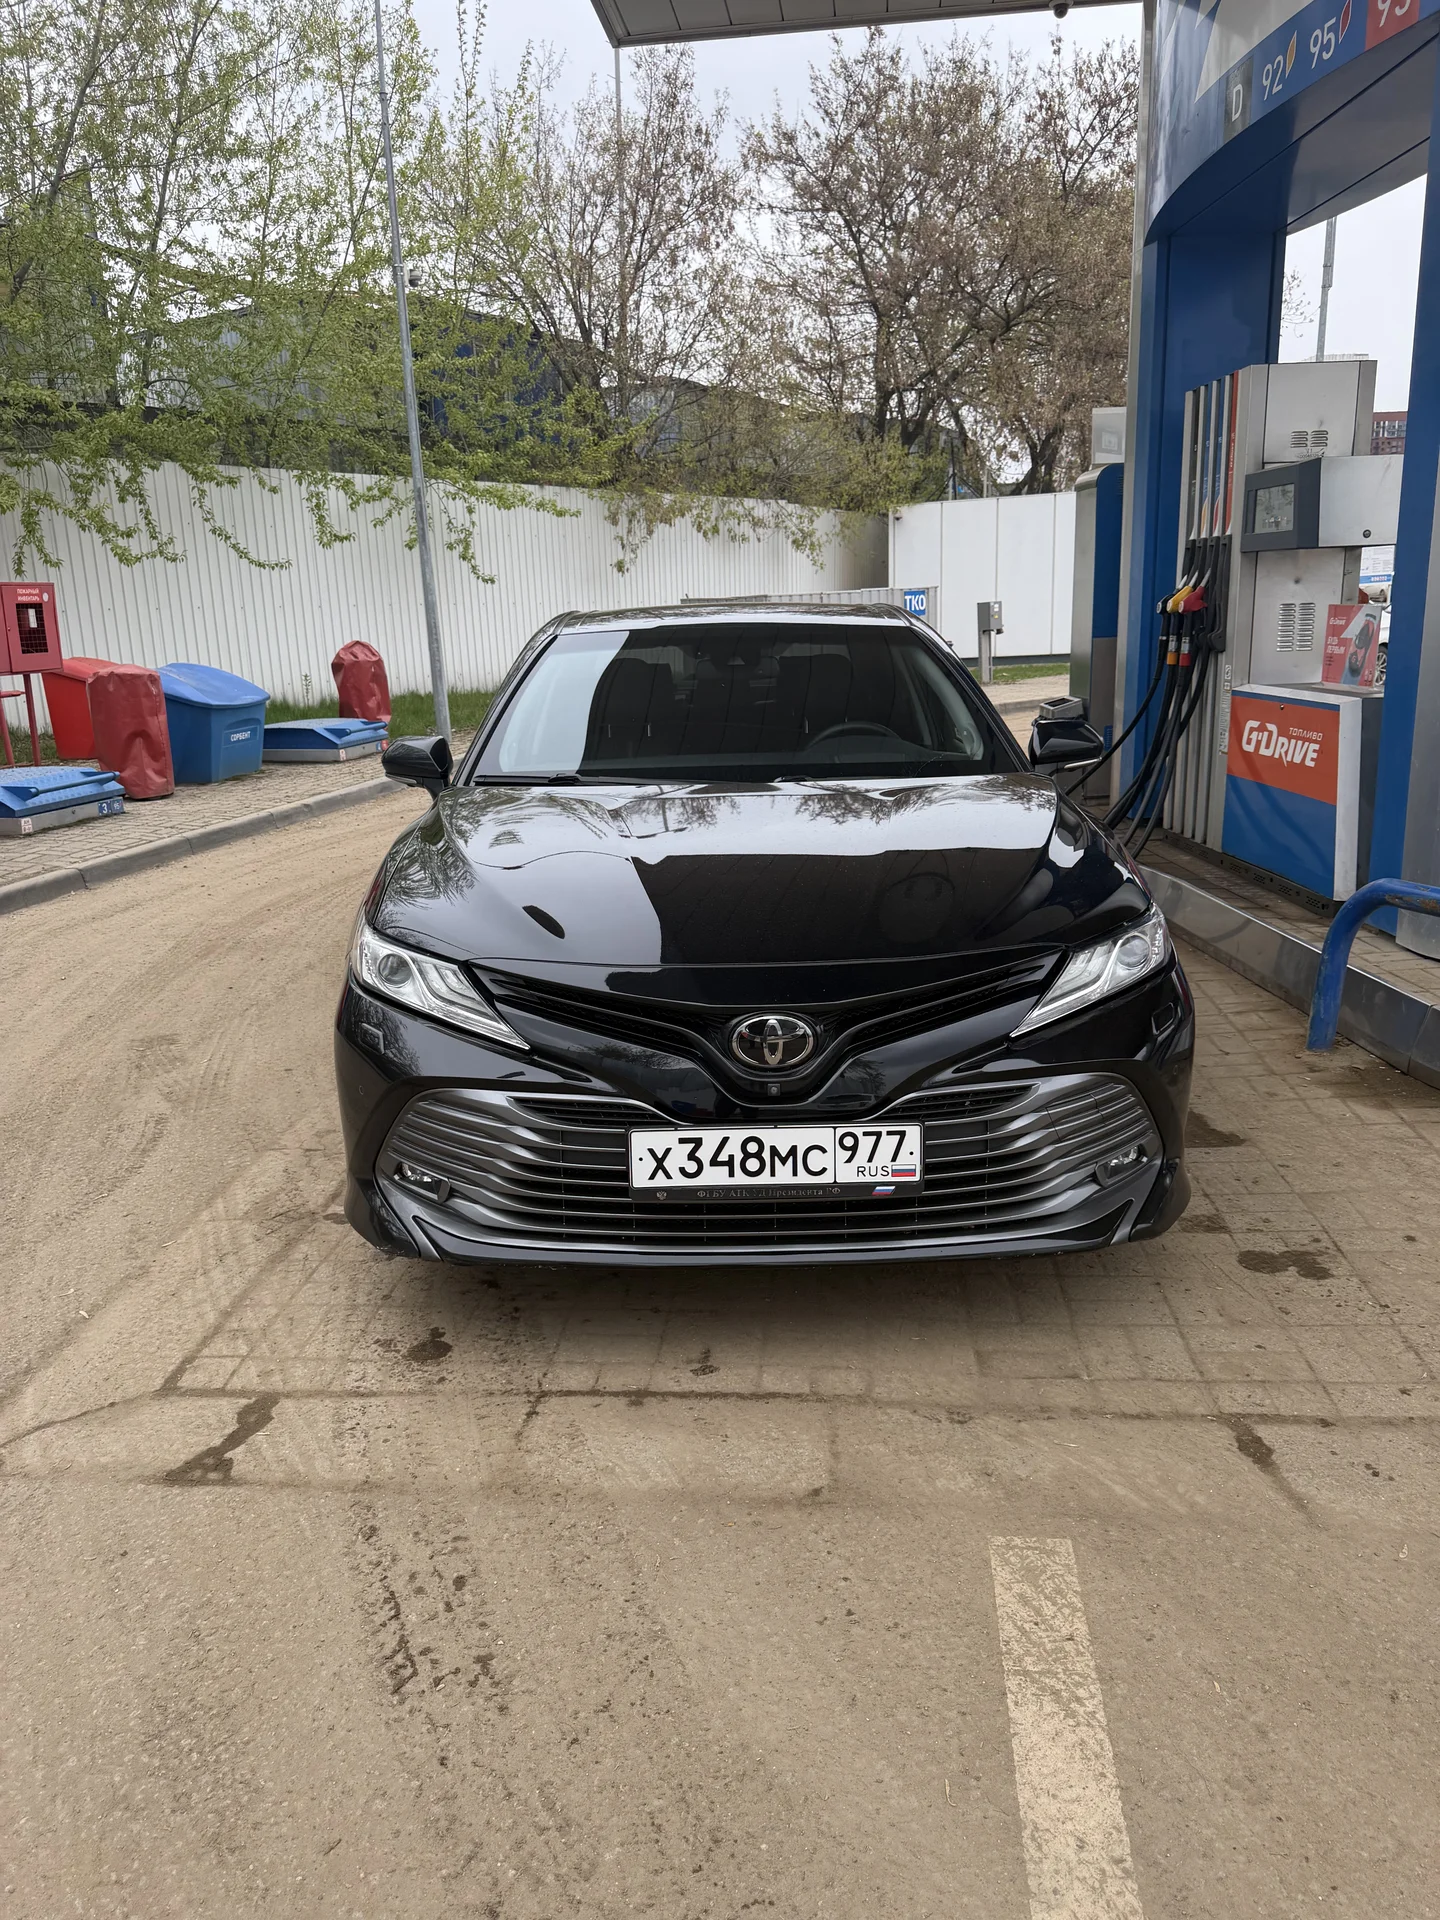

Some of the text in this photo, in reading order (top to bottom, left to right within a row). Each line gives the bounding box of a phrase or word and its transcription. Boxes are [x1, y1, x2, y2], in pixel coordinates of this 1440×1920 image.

[1231, 84, 1243, 122] D
[1262, 55, 1284, 101] 92
[1309, 17, 1336, 69] 95
[904, 594, 926, 611] ТКО
[230, 731, 251, 742] СОРБЕНТ
[1289, 727, 1323, 741] ТОПЛИВО
[101, 803, 108, 814] 3
[646, 1131, 907, 1181] Х348МС 977
[856, 1165, 890, 1178] RUS
